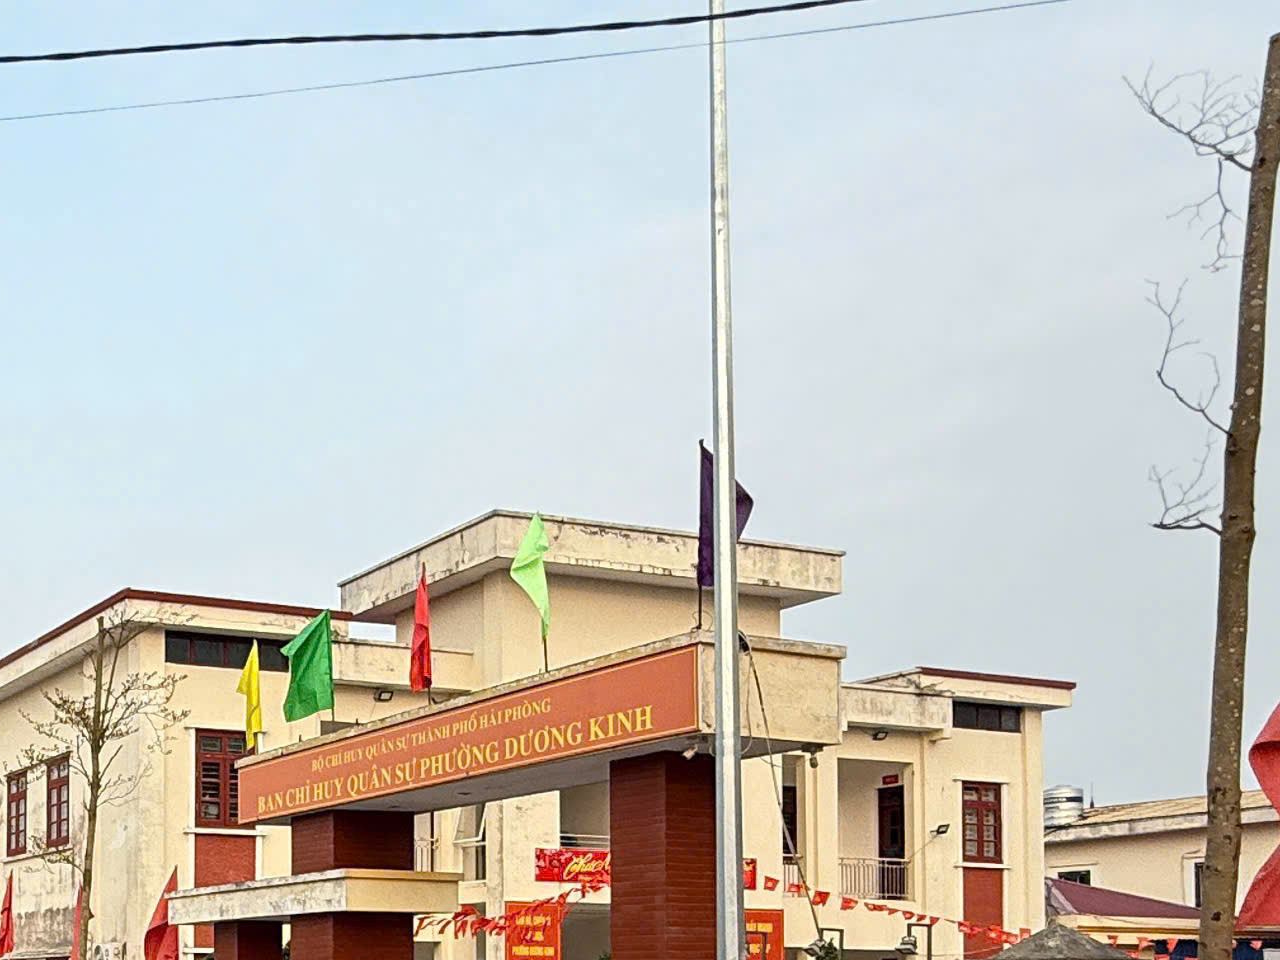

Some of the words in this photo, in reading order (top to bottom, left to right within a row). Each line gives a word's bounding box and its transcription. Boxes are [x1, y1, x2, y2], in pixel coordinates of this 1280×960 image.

[257, 790, 284, 814] BAN
[285, 779, 311, 807] CHỈ
[313, 776, 345, 802] HUY
[347, 763, 392, 797] QUÂN
[394, 757, 417, 786] SỰ
[419, 741, 500, 778] PHƯỜNG
[504, 720, 583, 760] DƯƠNG
[589, 704, 654, 741] KINH
[312, 754, 324, 773] BỘ
[343, 748, 364, 764] HUY
[365, 737, 395, 760] QUÂN
[396, 734, 410, 752] SỰ
[410, 723, 451, 747] THÀNH
[452, 710, 478, 736] PHỐ
[479, 710, 503, 728] HẢI
[504, 698, 551, 723] PHÒNG
